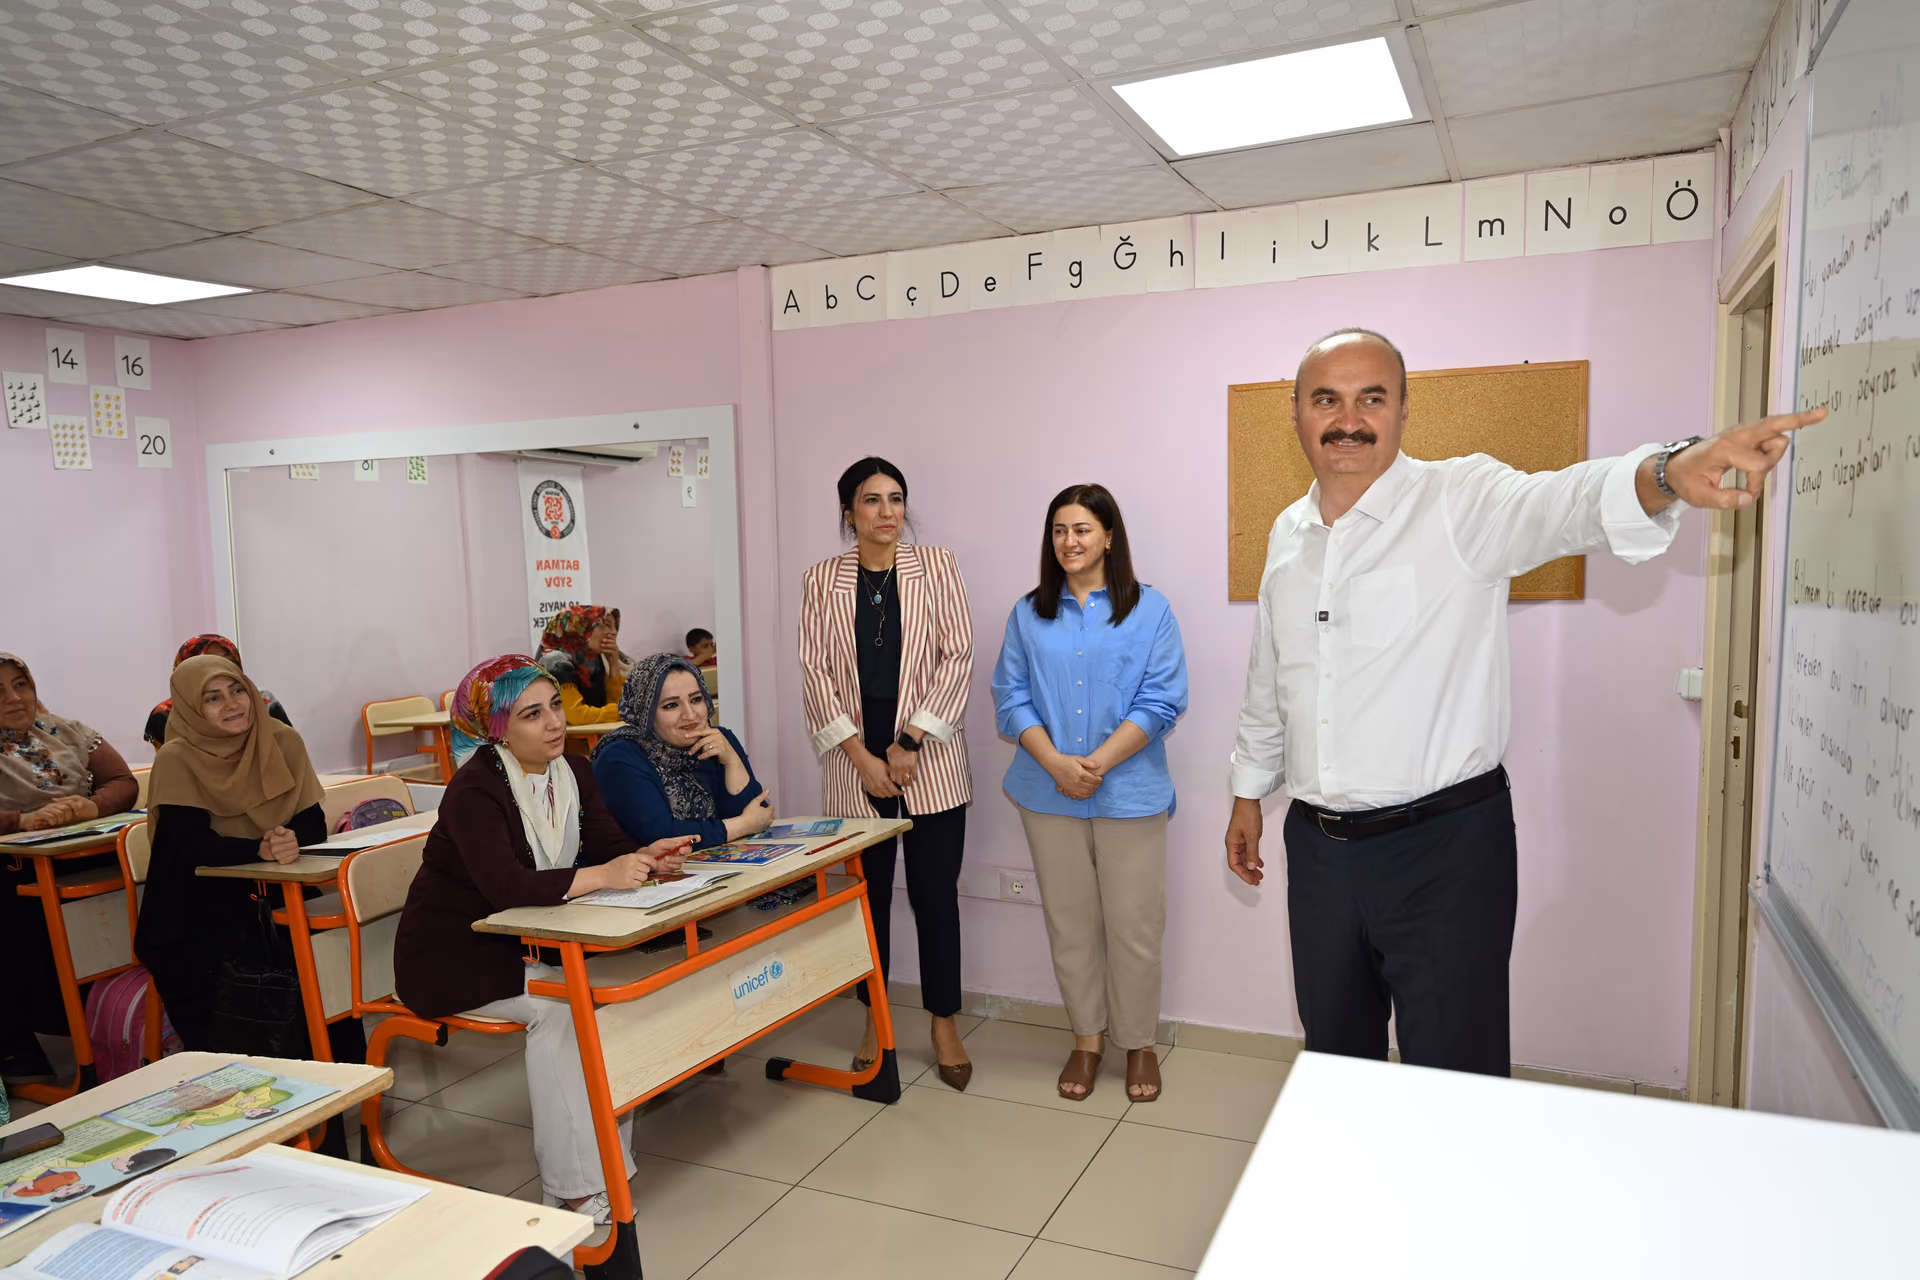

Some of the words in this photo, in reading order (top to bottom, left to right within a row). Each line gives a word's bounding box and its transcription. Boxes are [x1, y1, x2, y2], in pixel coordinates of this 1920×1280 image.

[783, 289, 801, 315] A
[825, 284, 838, 310] b
[856, 274, 876, 301] C
[906, 286, 917, 307] ç
[940, 271, 960, 299] D
[984, 276, 997, 292] e
[1028, 251, 1043, 281] F
[1068, 260, 1083, 289] g
[1113, 235, 1137, 270] Ğ
[1169, 239, 1184, 268] h
[1272, 240, 1277, 264] i
[1310, 219, 1329, 250] J
[1367, 222, 1381, 253] k
[1424, 215, 1444, 247] L
[1478, 217, 1505, 238] m
[1544, 197, 1572, 232] N
[1608, 205, 1627, 226] o
[1666, 179, 1699, 221] Ö
[51, 347, 78, 370] 14
[121, 355, 144, 377] 16
[140, 434, 166, 456] 20
[1796, 456, 1822, 506] Cenup
[734, 965, 769, 1000] unicef
